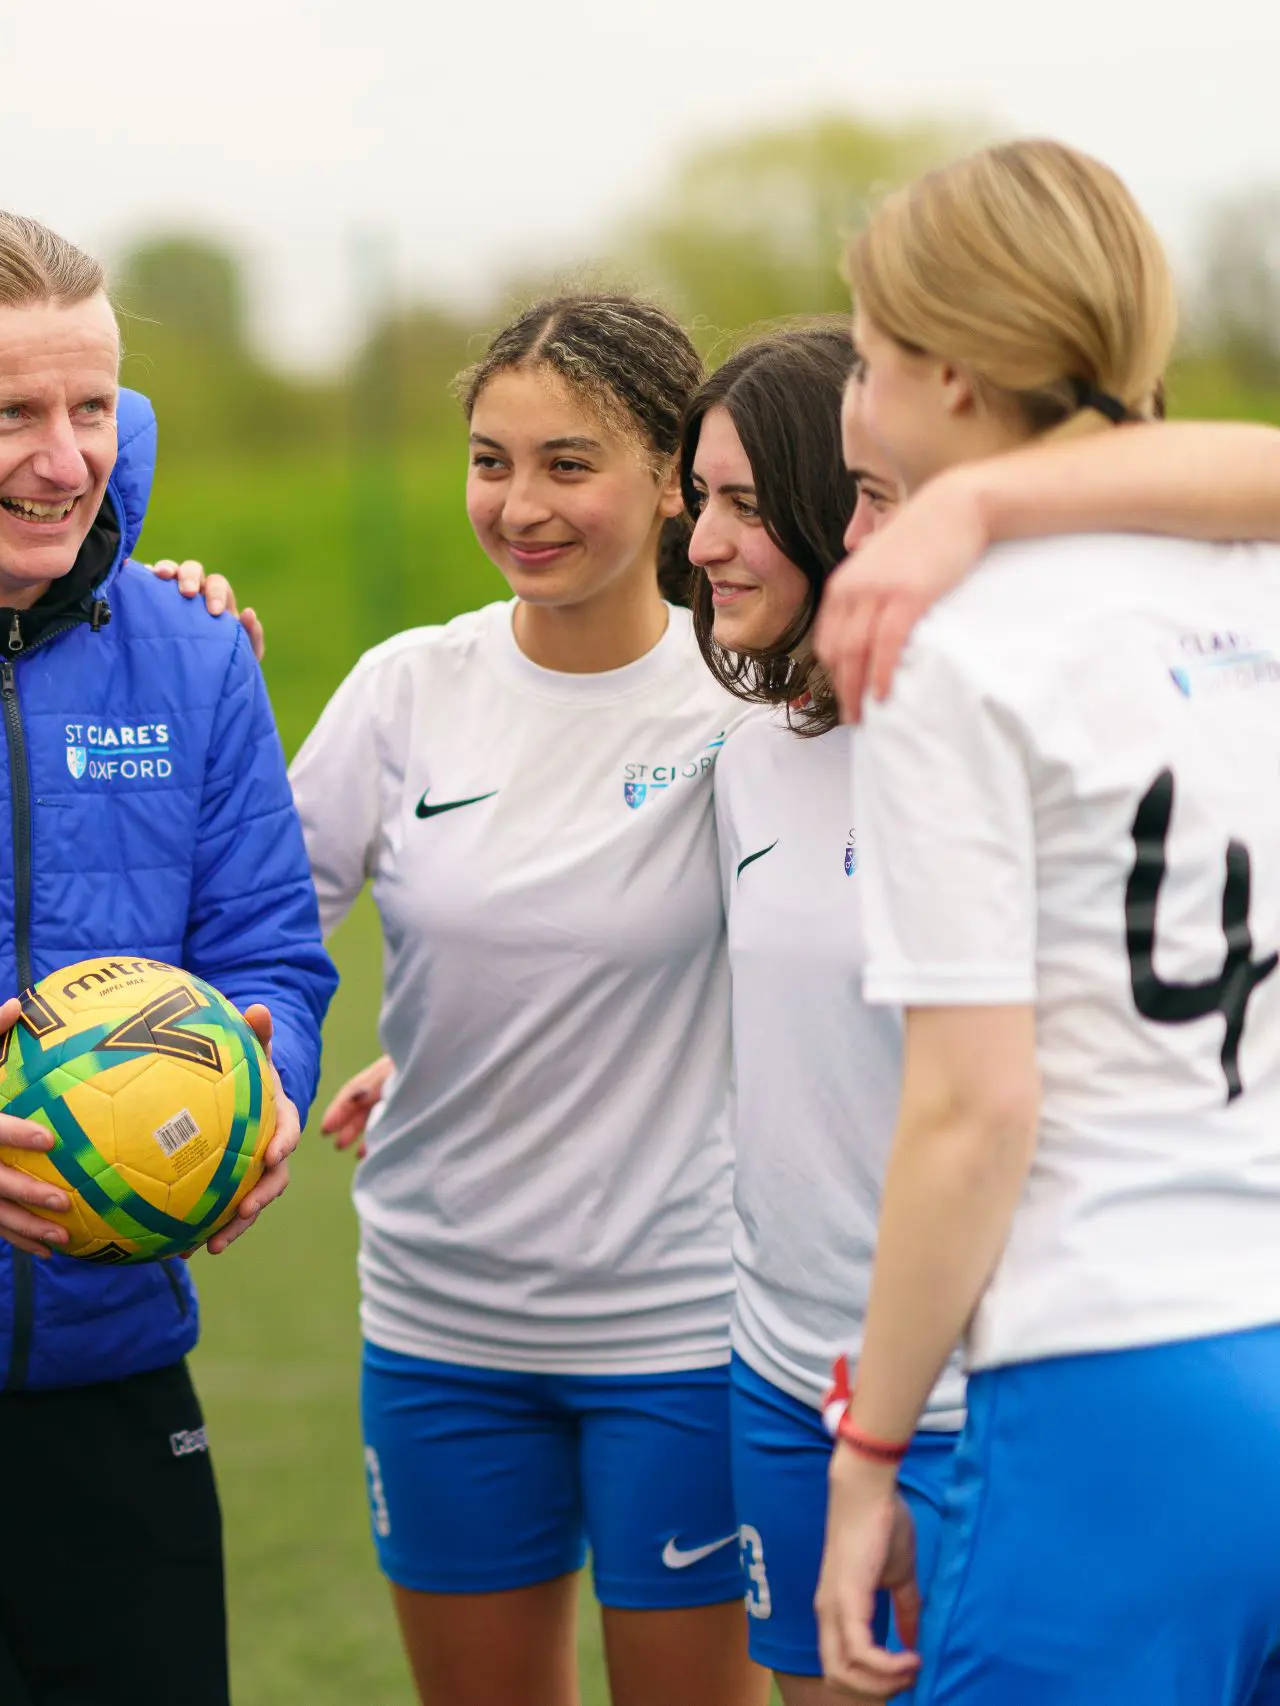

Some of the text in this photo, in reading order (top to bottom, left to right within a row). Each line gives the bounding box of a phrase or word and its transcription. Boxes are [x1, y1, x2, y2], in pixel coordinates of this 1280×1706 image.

[87, 724, 169, 746] CLARE'S
[89, 759, 172, 780] OXFORD
[624, 763, 648, 780] ST
[847, 828, 857, 846] S
[1125, 764, 1280, 1107] 4
[62, 961, 173, 1000] mitre
[99, 978, 145, 997] IMPEL MAX
